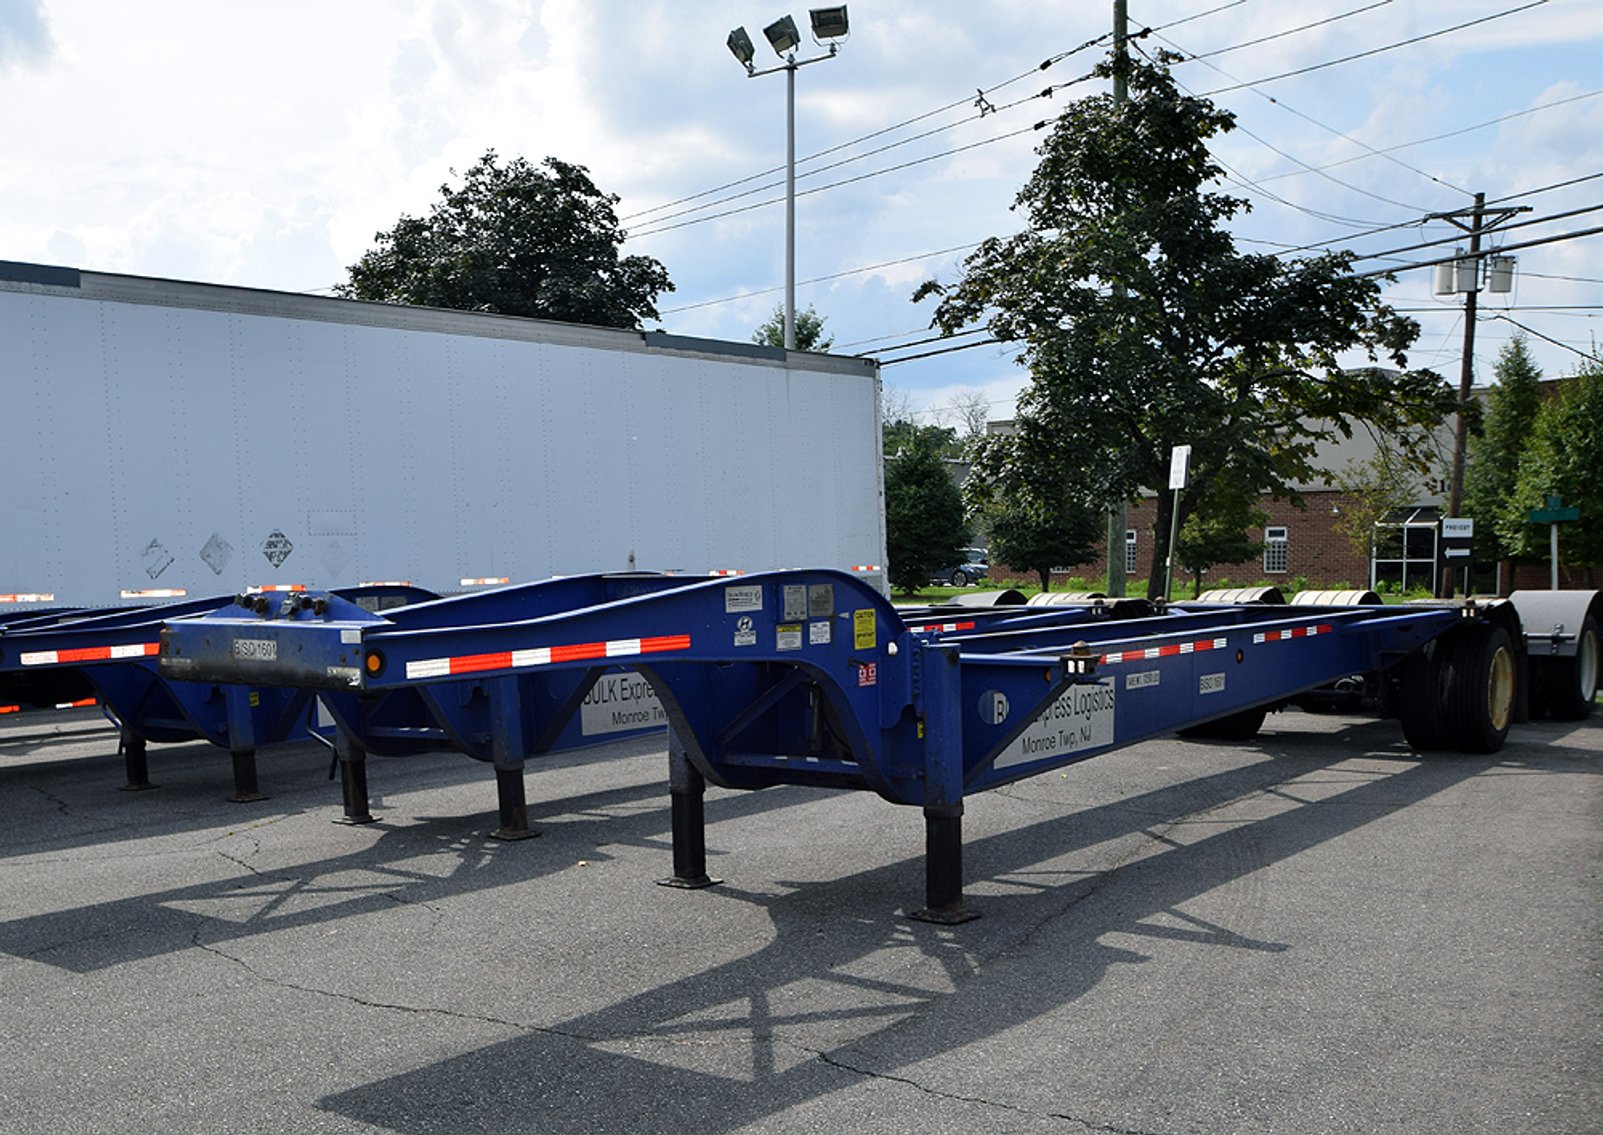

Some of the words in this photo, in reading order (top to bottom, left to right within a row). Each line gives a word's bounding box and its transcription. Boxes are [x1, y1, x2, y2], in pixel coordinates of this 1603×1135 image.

[620, 678, 657, 705] Expre
[1074, 686, 1114, 721] Logistics
[612, 711, 649, 726] Monroe
[652, 706, 668, 722] Tw
[1021, 735, 1056, 754] Monroe
[1080, 724, 1092, 743] NJ
